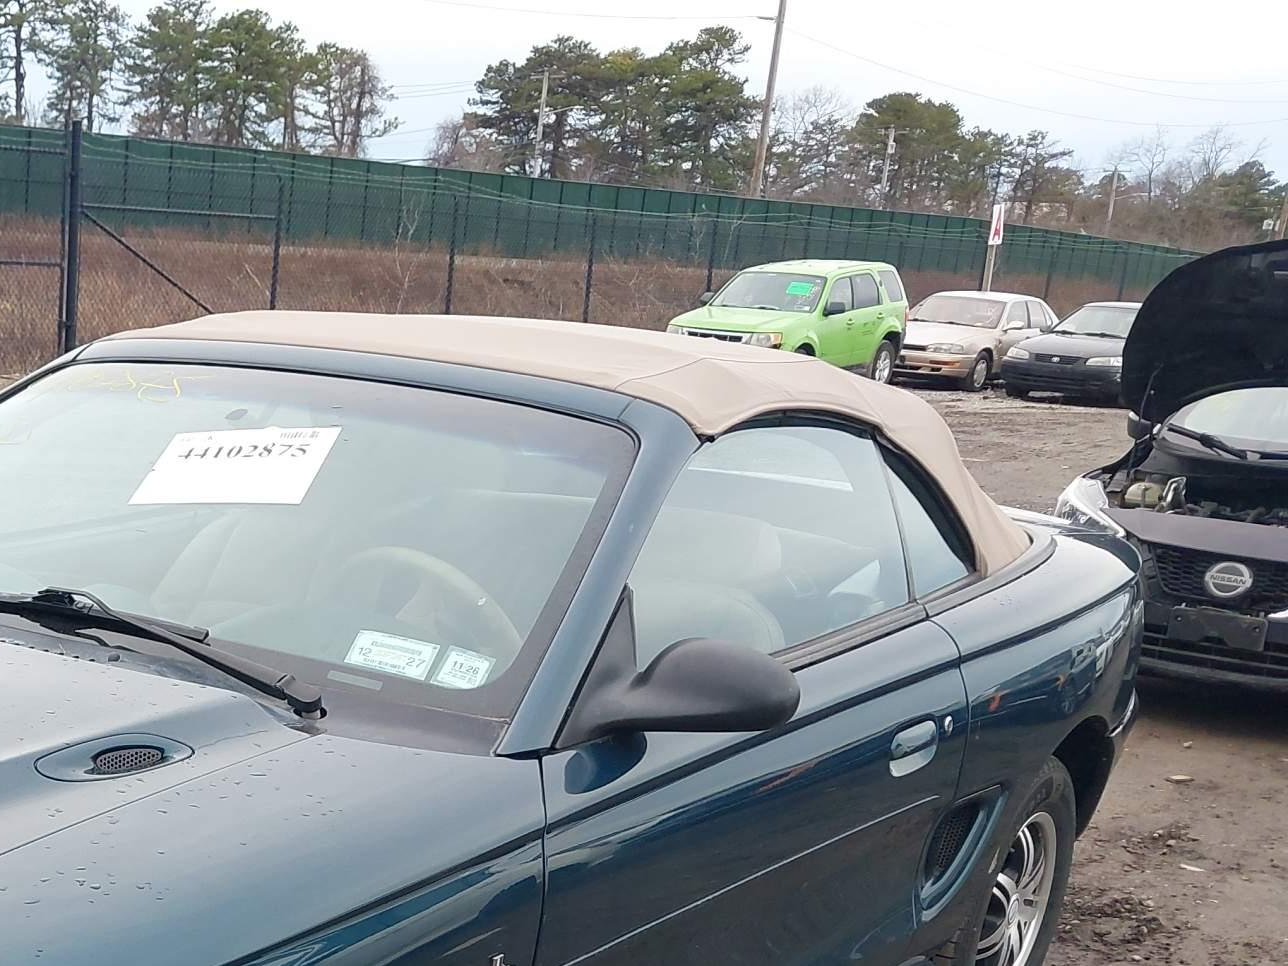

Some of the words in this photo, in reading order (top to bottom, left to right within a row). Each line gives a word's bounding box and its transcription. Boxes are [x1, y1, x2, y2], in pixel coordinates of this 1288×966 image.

[177, 442, 312, 460] 44102875
[1210, 574, 1247, 585] NISSAN
[358, 647, 372, 658] 12
[406, 656, 426, 669] 27
